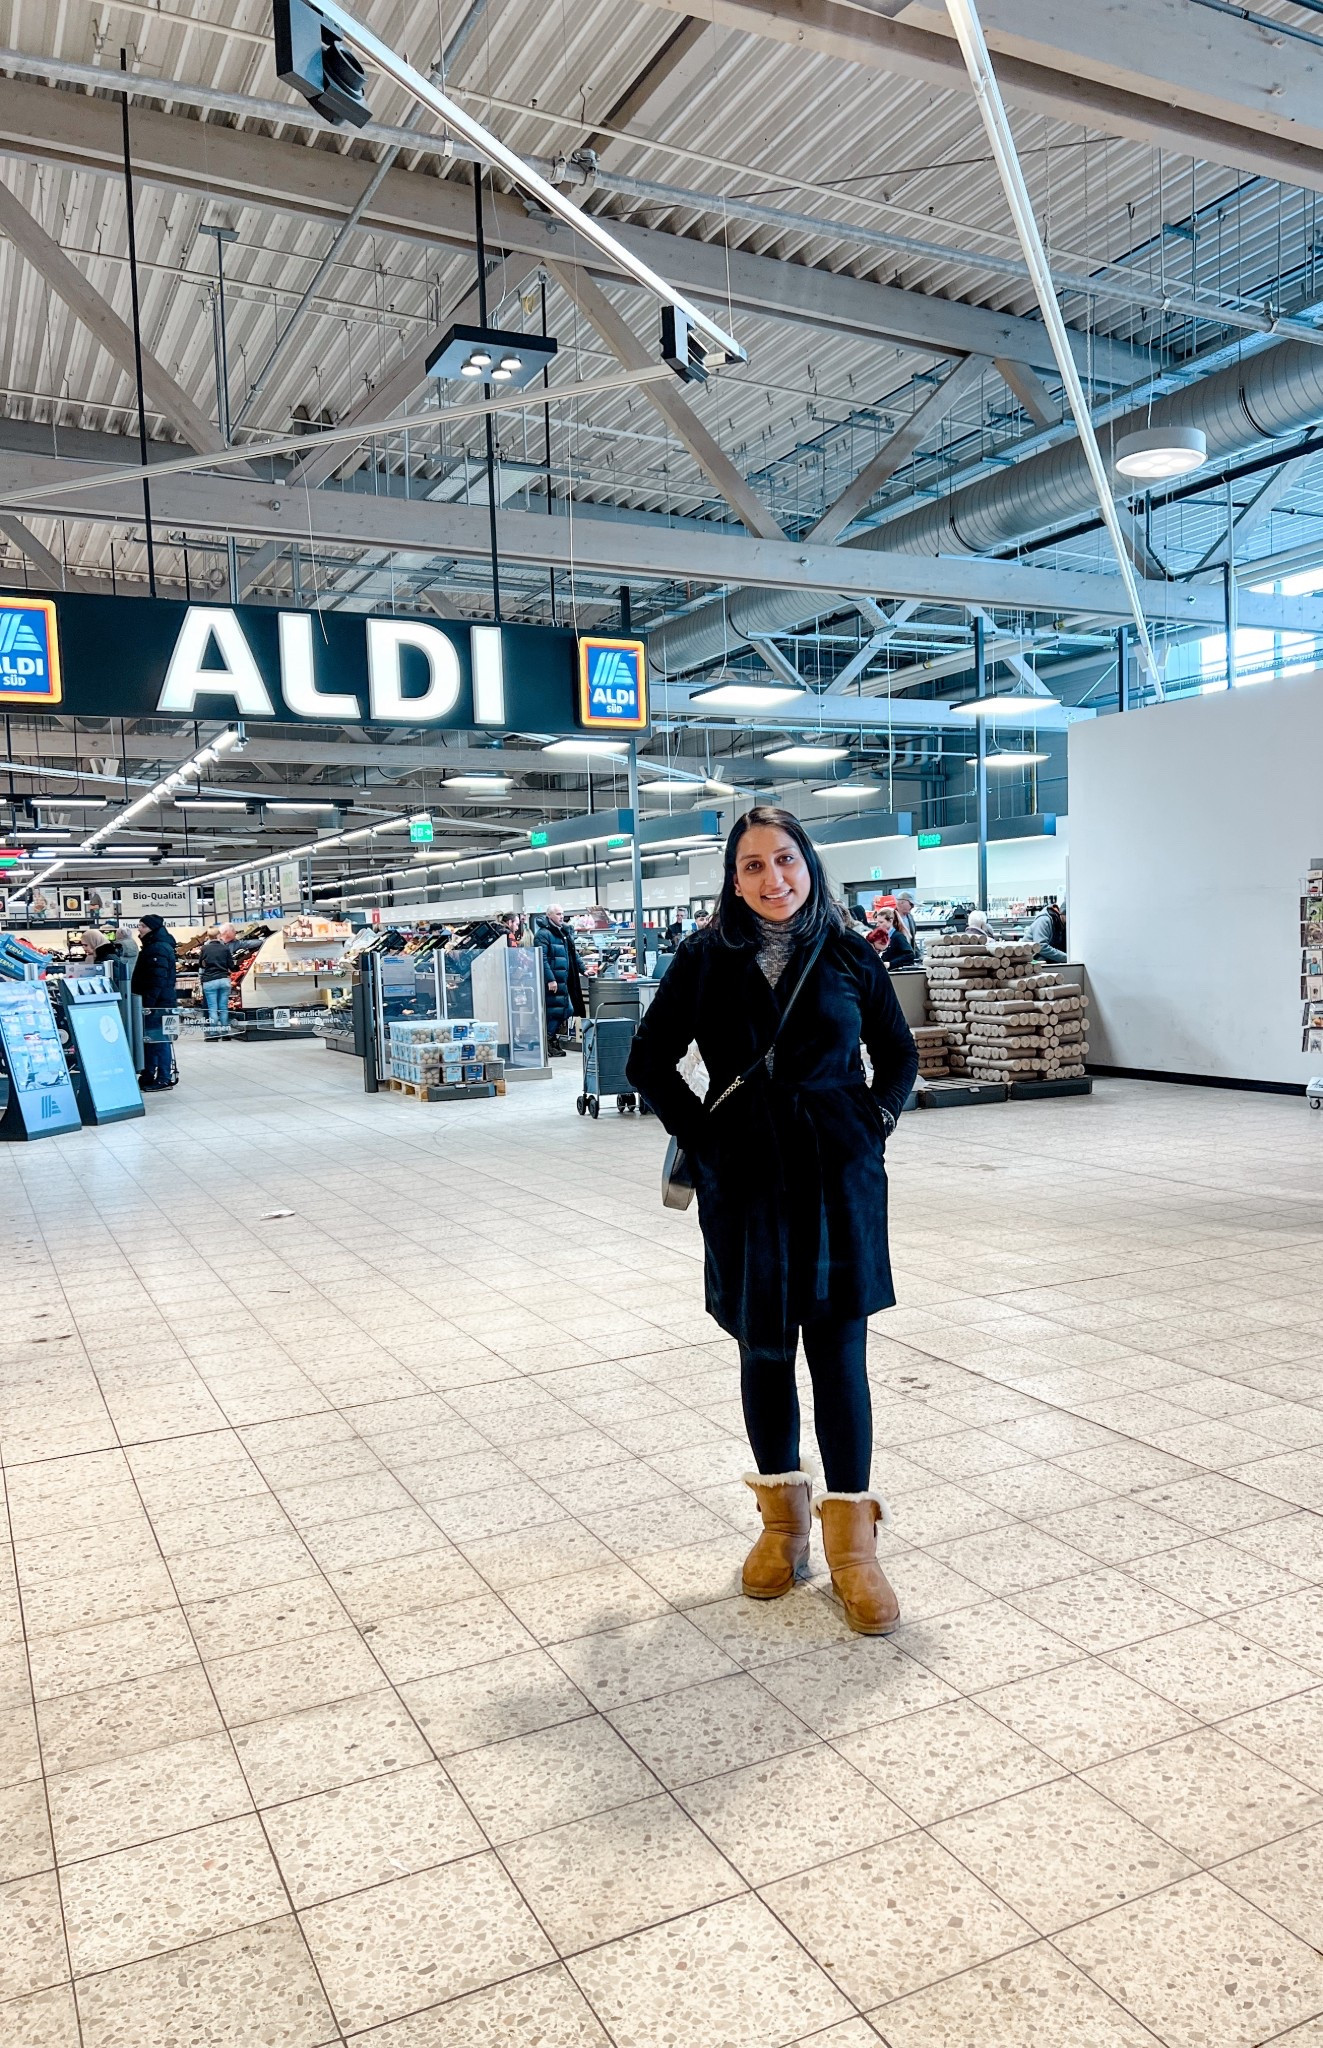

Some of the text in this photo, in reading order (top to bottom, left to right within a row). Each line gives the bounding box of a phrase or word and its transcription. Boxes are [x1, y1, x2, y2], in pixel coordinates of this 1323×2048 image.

[0, 656, 44, 676] LDI
[156, 605, 507, 726] ALDI
[3, 675, 26, 686] SÜD
[592, 687, 635, 705] ALDI
[606, 703, 623, 714] SÜD
[919, 834, 941, 846] Kasse
[132, 891, 187, 901] Bio-Qualität
